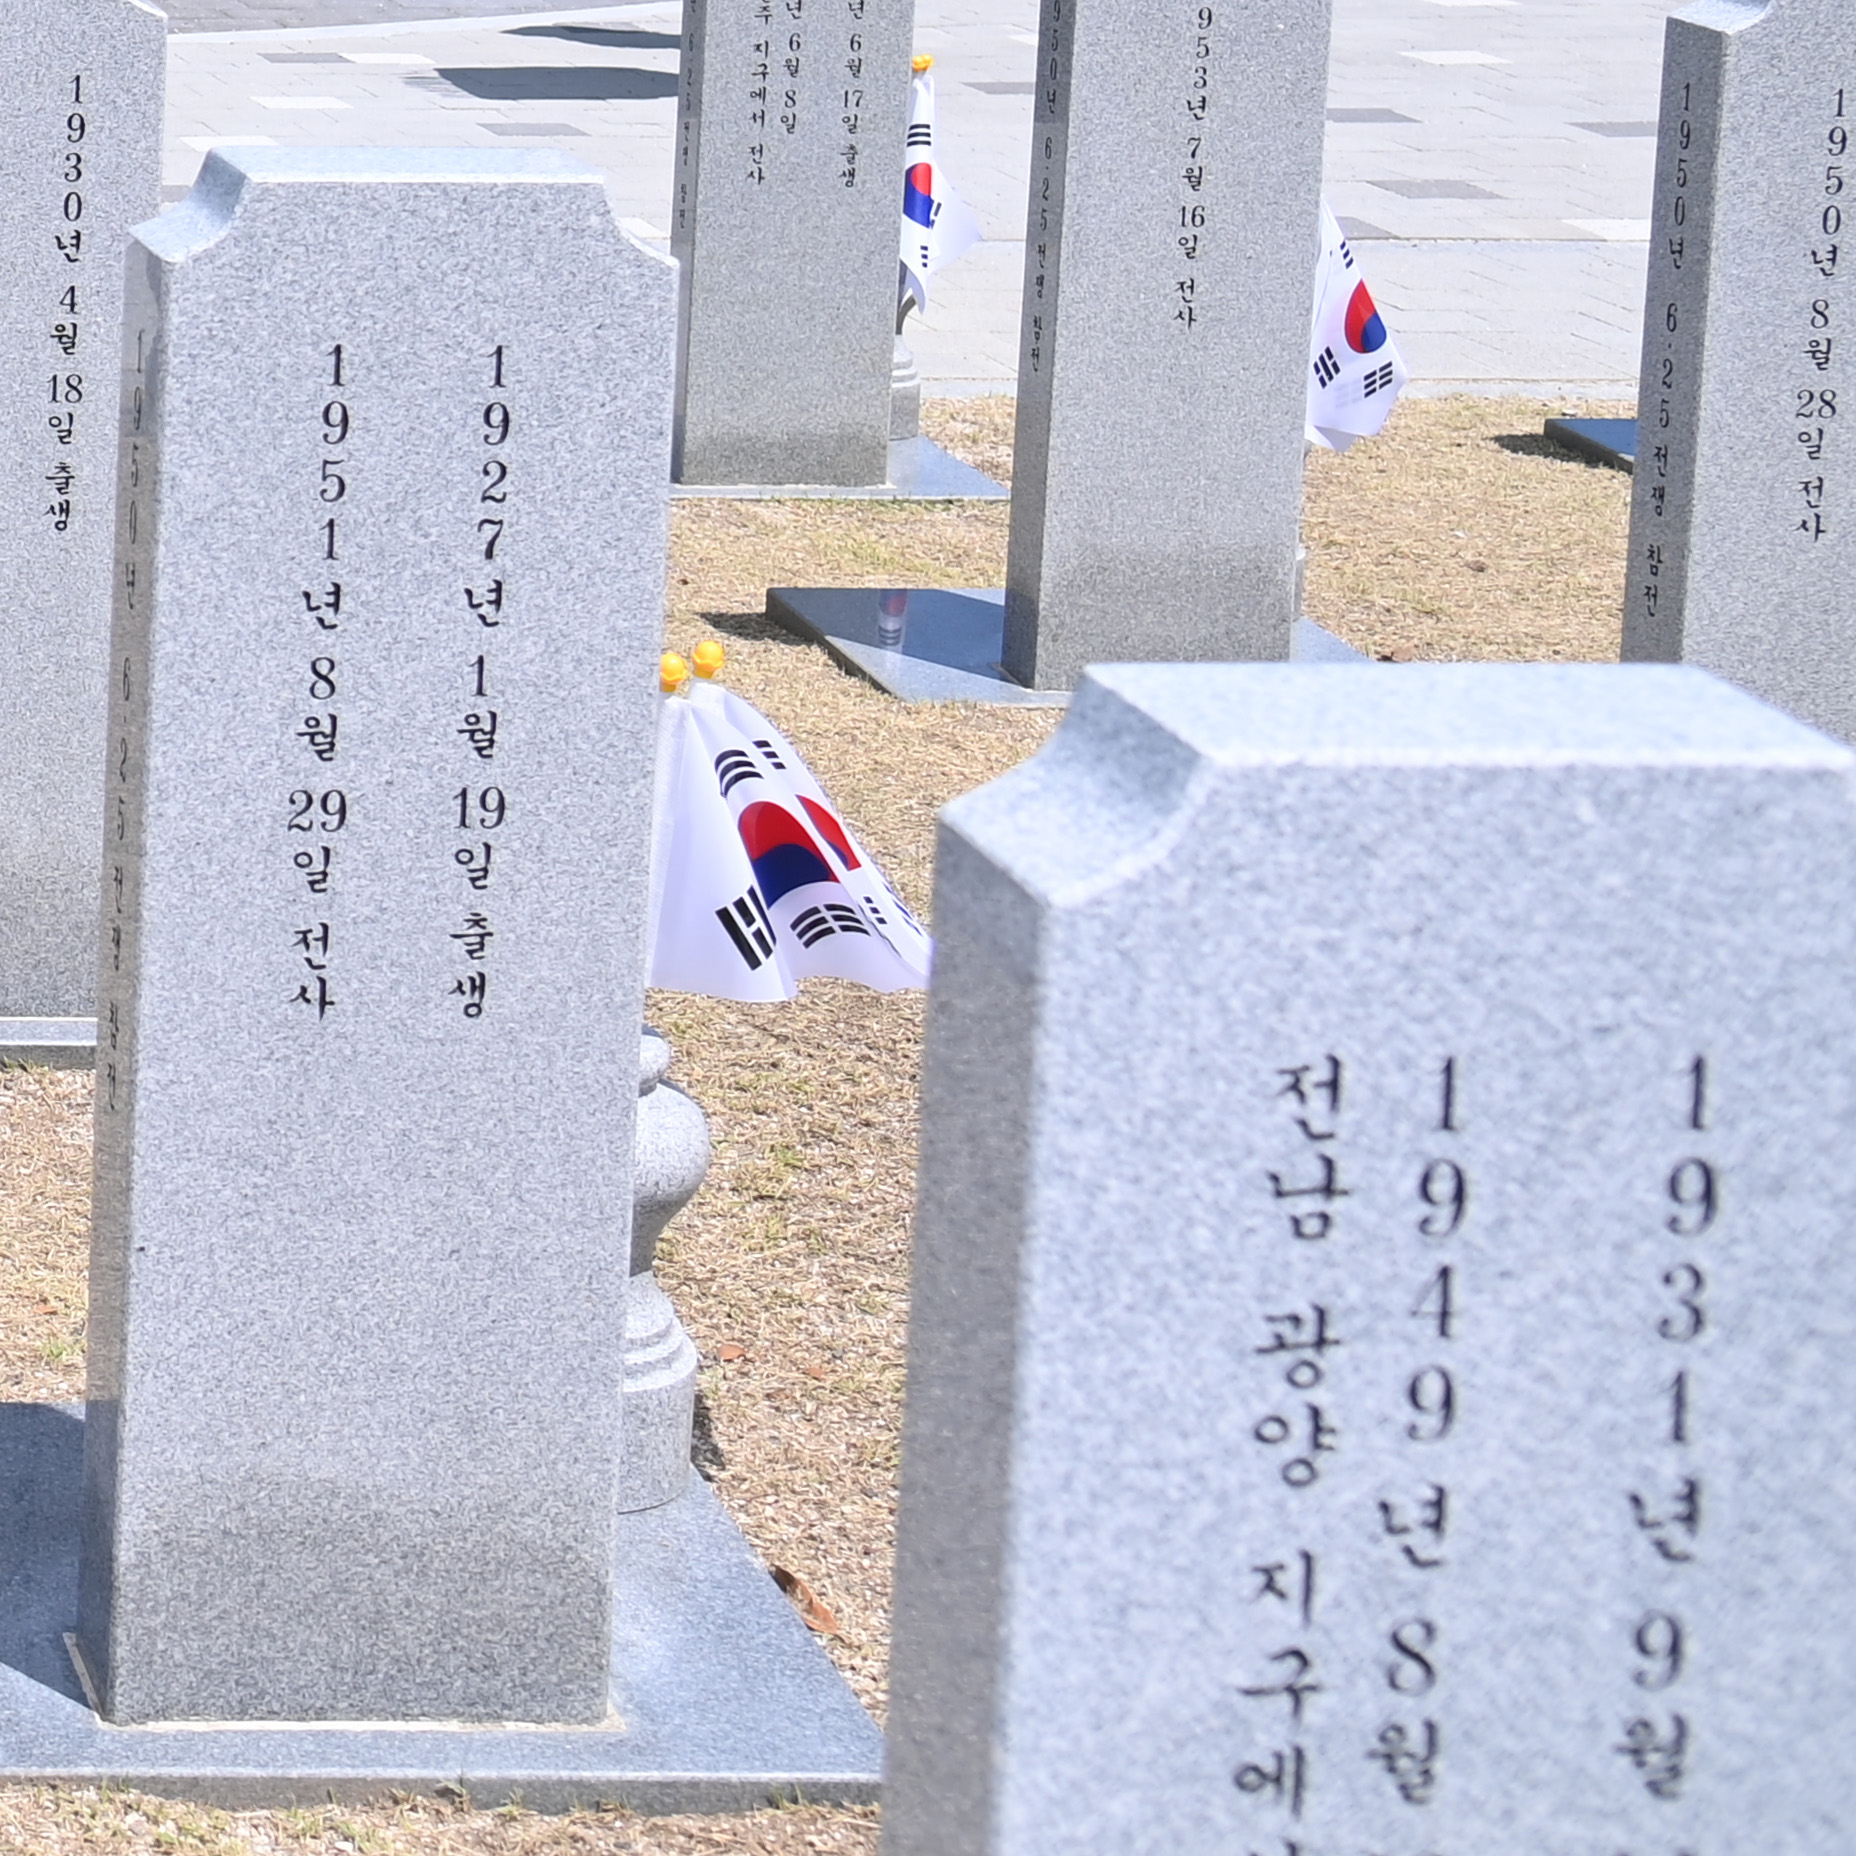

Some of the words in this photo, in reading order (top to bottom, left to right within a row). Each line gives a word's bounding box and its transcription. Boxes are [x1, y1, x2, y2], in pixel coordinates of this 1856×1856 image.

[750, 41, 769, 127] 지구에서
[785, 34, 801, 78] 6월
[846, 34, 862, 78] 6월
[781, 90, 796, 134] 8일
[842, 90, 863, 134] 17일
[55, 75, 85, 263] 1930년
[748, 144, 764, 184] 전사
[841, 144, 858, 187] 출생
[1183, 137, 1202, 191] 7월
[1669, 83, 1691, 270] 1950년
[1811, 89, 1847, 277] 1950년
[1179, 206, 1205, 259] 16일
[51, 286, 77, 355] 4월
[1176, 278, 1196, 327] 전사
[1805, 300, 1831, 370] 8월
[49, 375, 82, 444] 18일
[1796, 390, 1836, 460] 28일
[46, 462, 74, 531] 출생
[125, 329, 147, 610] 1950년
[303, 344, 349, 630] 1951년
[465, 345, 510, 627] 1927년
[1800, 477, 1826, 540] 전사
[1645, 544, 1663, 617] 참전
[297, 658, 337, 761] 8월
[458, 655, 497, 759] 1월
[288, 790, 347, 893] 29일
[454, 787, 506, 890] 19일
[291, 923, 335, 1018] 전사
[450, 913, 493, 1018] 출생
[1268, 1055, 1349, 1240] 전남
[1378, 1057, 1467, 1569] 1949년
[1628, 1055, 1717, 1563] 1931년
[1253, 1304, 1340, 1488] 광양
[1234, 1549, 1322, 1856] 지구에
[1368, 1620, 1438, 1804] 8월
[1618, 1616, 1688, 1798] 9월
